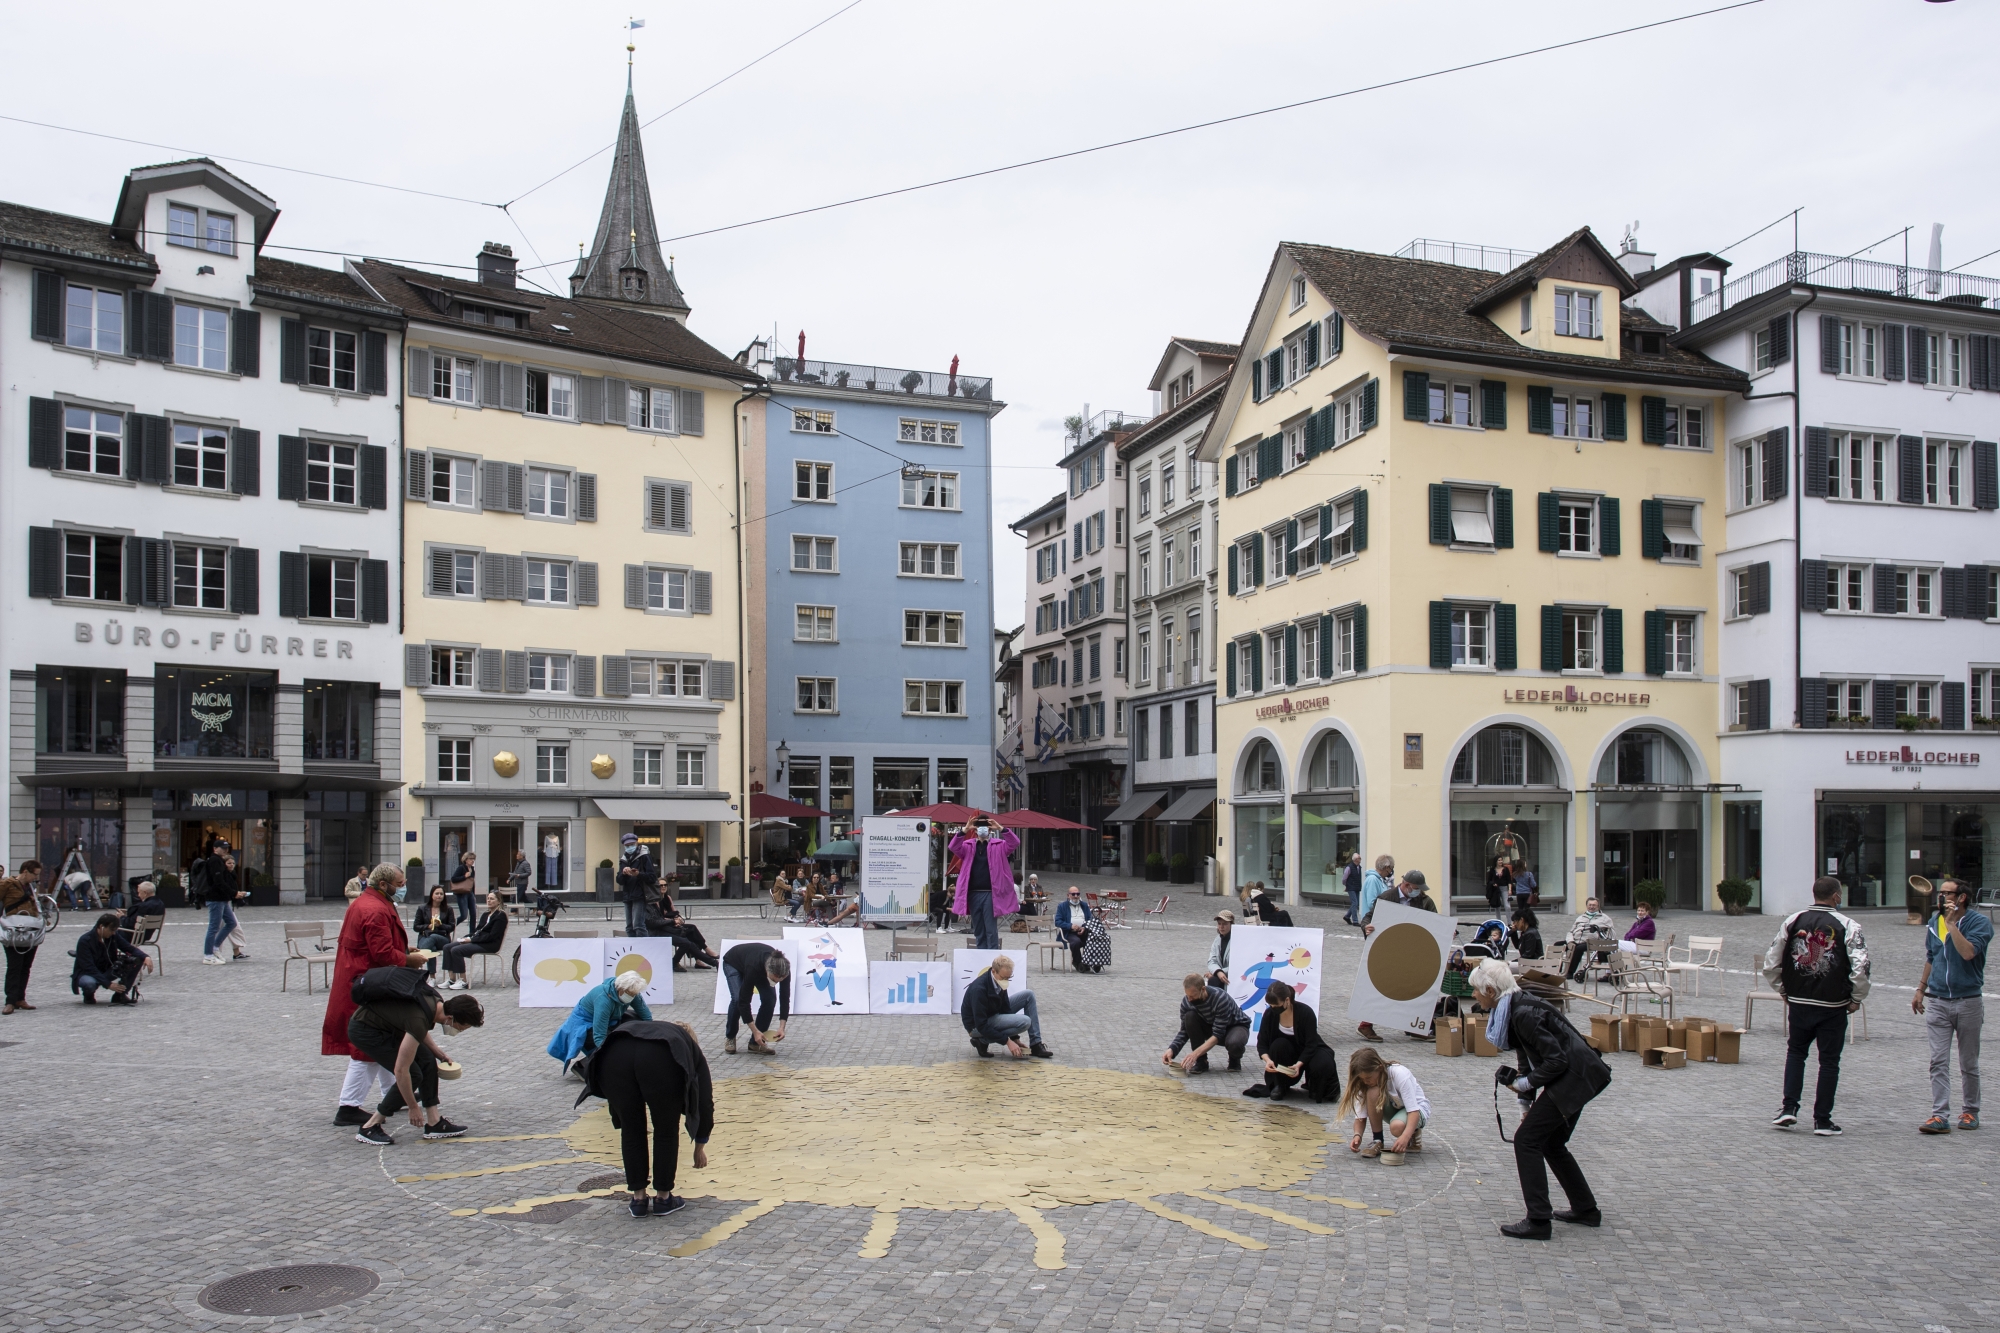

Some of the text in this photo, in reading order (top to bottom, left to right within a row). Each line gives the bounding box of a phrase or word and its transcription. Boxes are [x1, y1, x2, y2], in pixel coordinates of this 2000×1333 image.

[191, 692, 232, 707] MCM
[1504, 689, 1563, 701] LEDER
[1580, 691, 1650, 704] LOCHER
[528, 706, 630, 722] SCHIRMFABRIK
[1255, 704, 1284, 717] LEDER
[1289, 696, 1329, 712] LOCHER
[1846, 750, 1900, 762] LEDER
[1915, 752, 1980, 763] LOCHER
[192, 793, 232, 807] MCM
[1410, 1016, 1426, 1030] Ja
